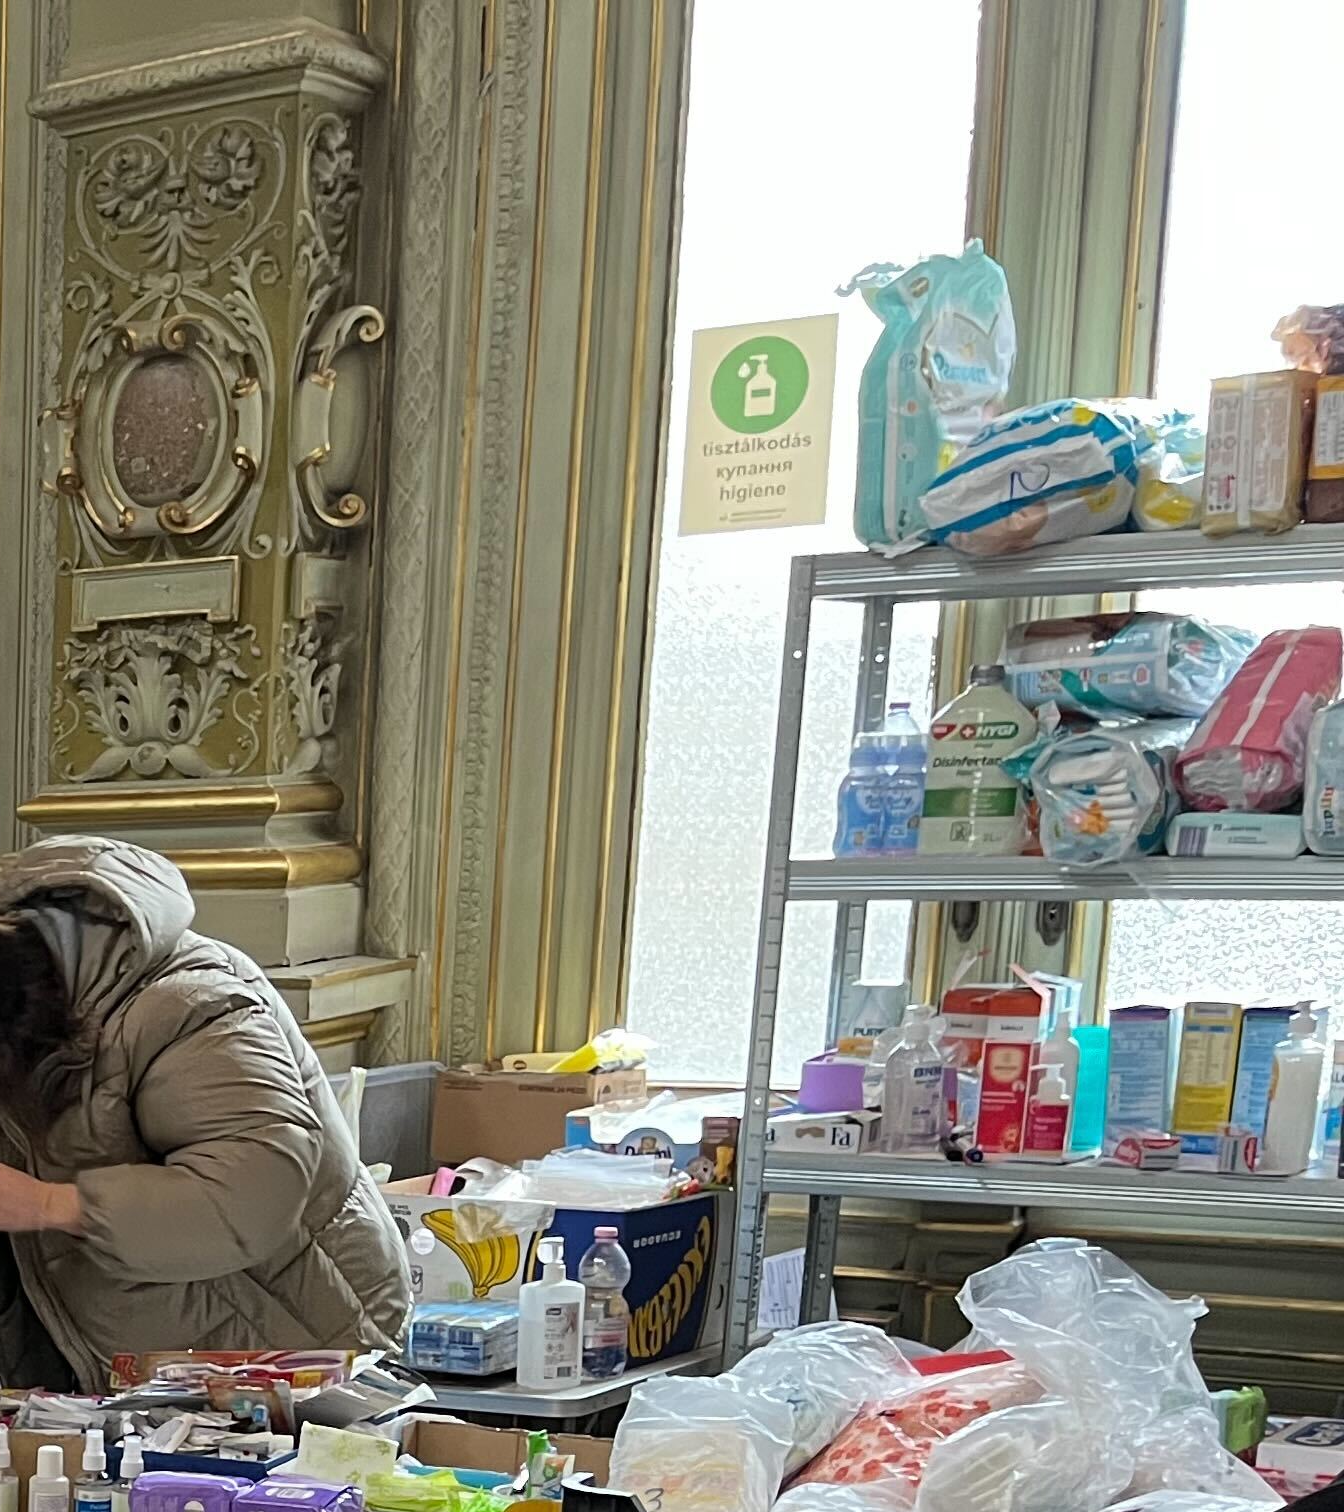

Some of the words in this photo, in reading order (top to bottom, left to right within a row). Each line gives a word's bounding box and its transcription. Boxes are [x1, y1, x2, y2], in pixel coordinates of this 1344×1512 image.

[703, 433, 812, 457] tisztálkodás
[716, 460, 793, 481] купання
[719, 483, 786, 503] higiene
[831, 1127, 851, 1147] Fa
[633, 1230, 682, 1248] ECUADOR
[644, 1487, 665, 1512] 3
